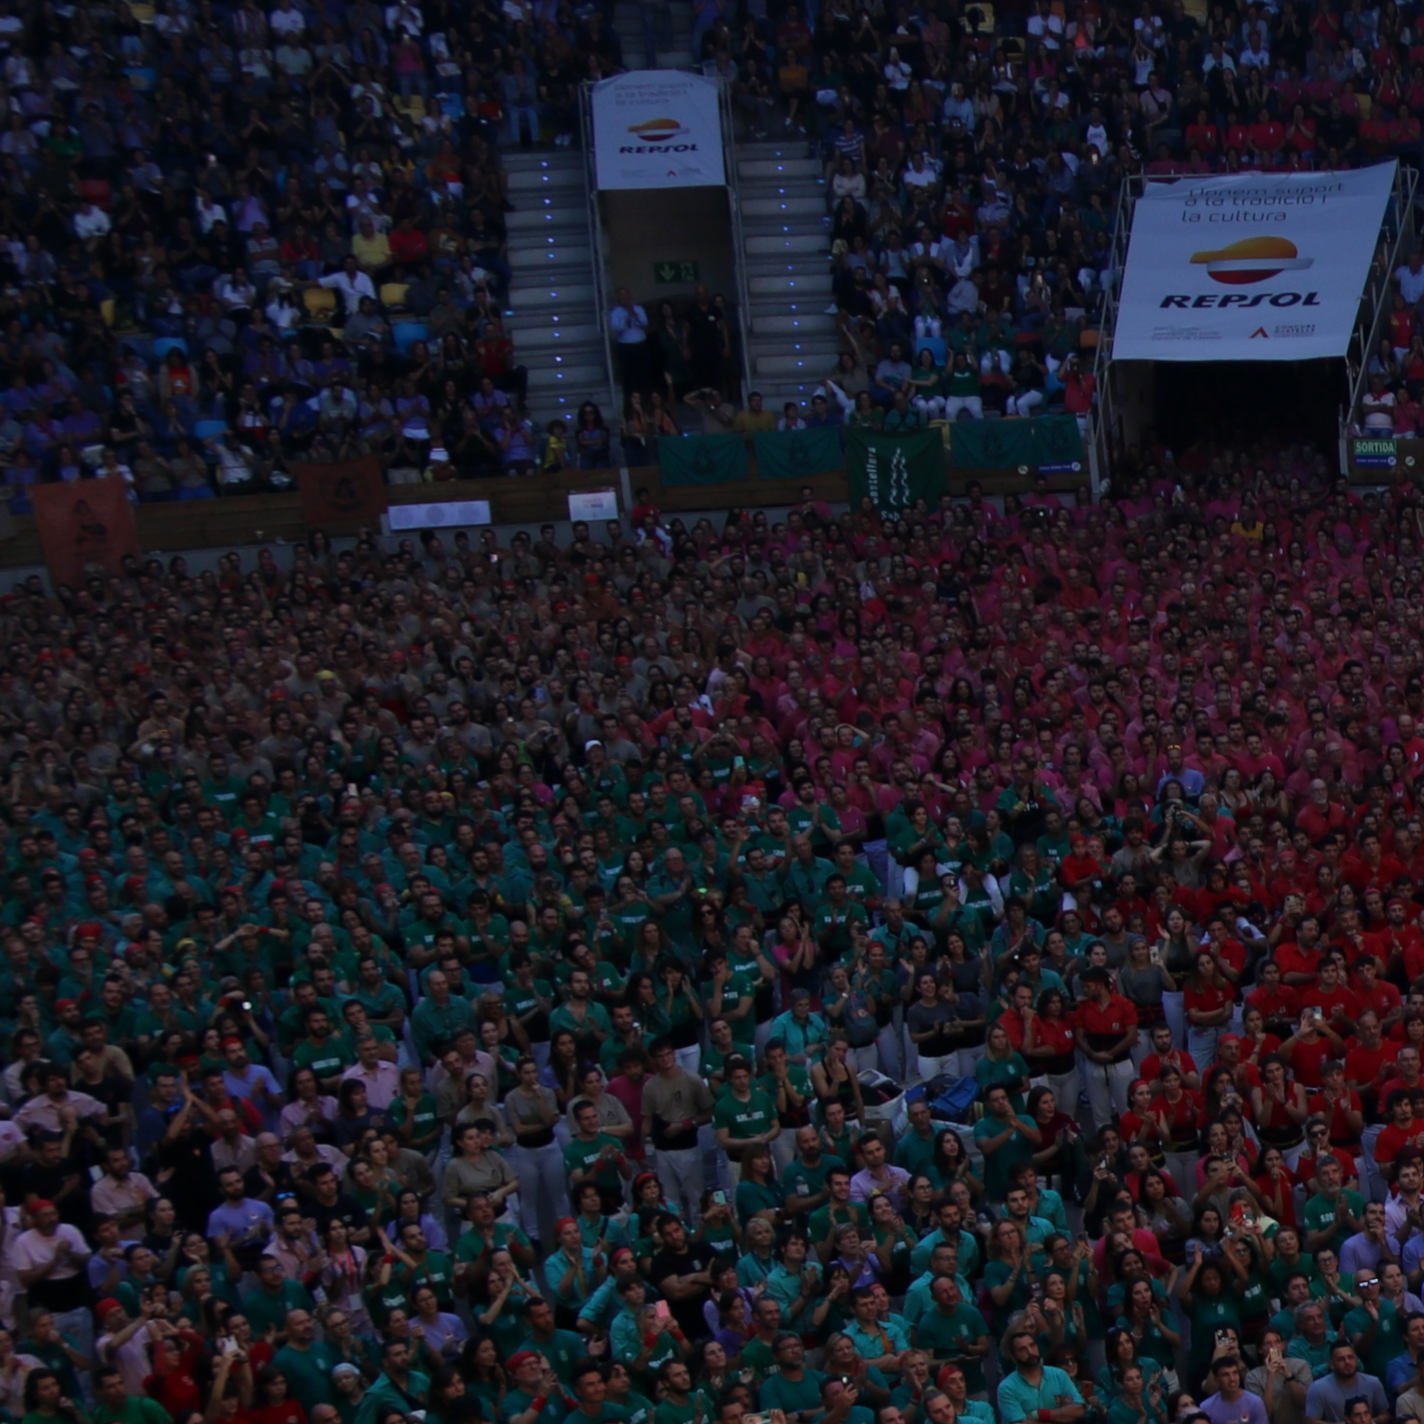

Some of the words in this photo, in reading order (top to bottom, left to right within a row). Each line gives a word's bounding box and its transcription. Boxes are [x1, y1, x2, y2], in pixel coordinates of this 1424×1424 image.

[619, 143, 699, 154] REPSOL
[1181, 210, 1201, 223] la
[1208, 210, 1287, 223] cultura
[1159, 291, 1320, 309] REPSOL
[1355, 441, 1395, 453] SORTIDA
